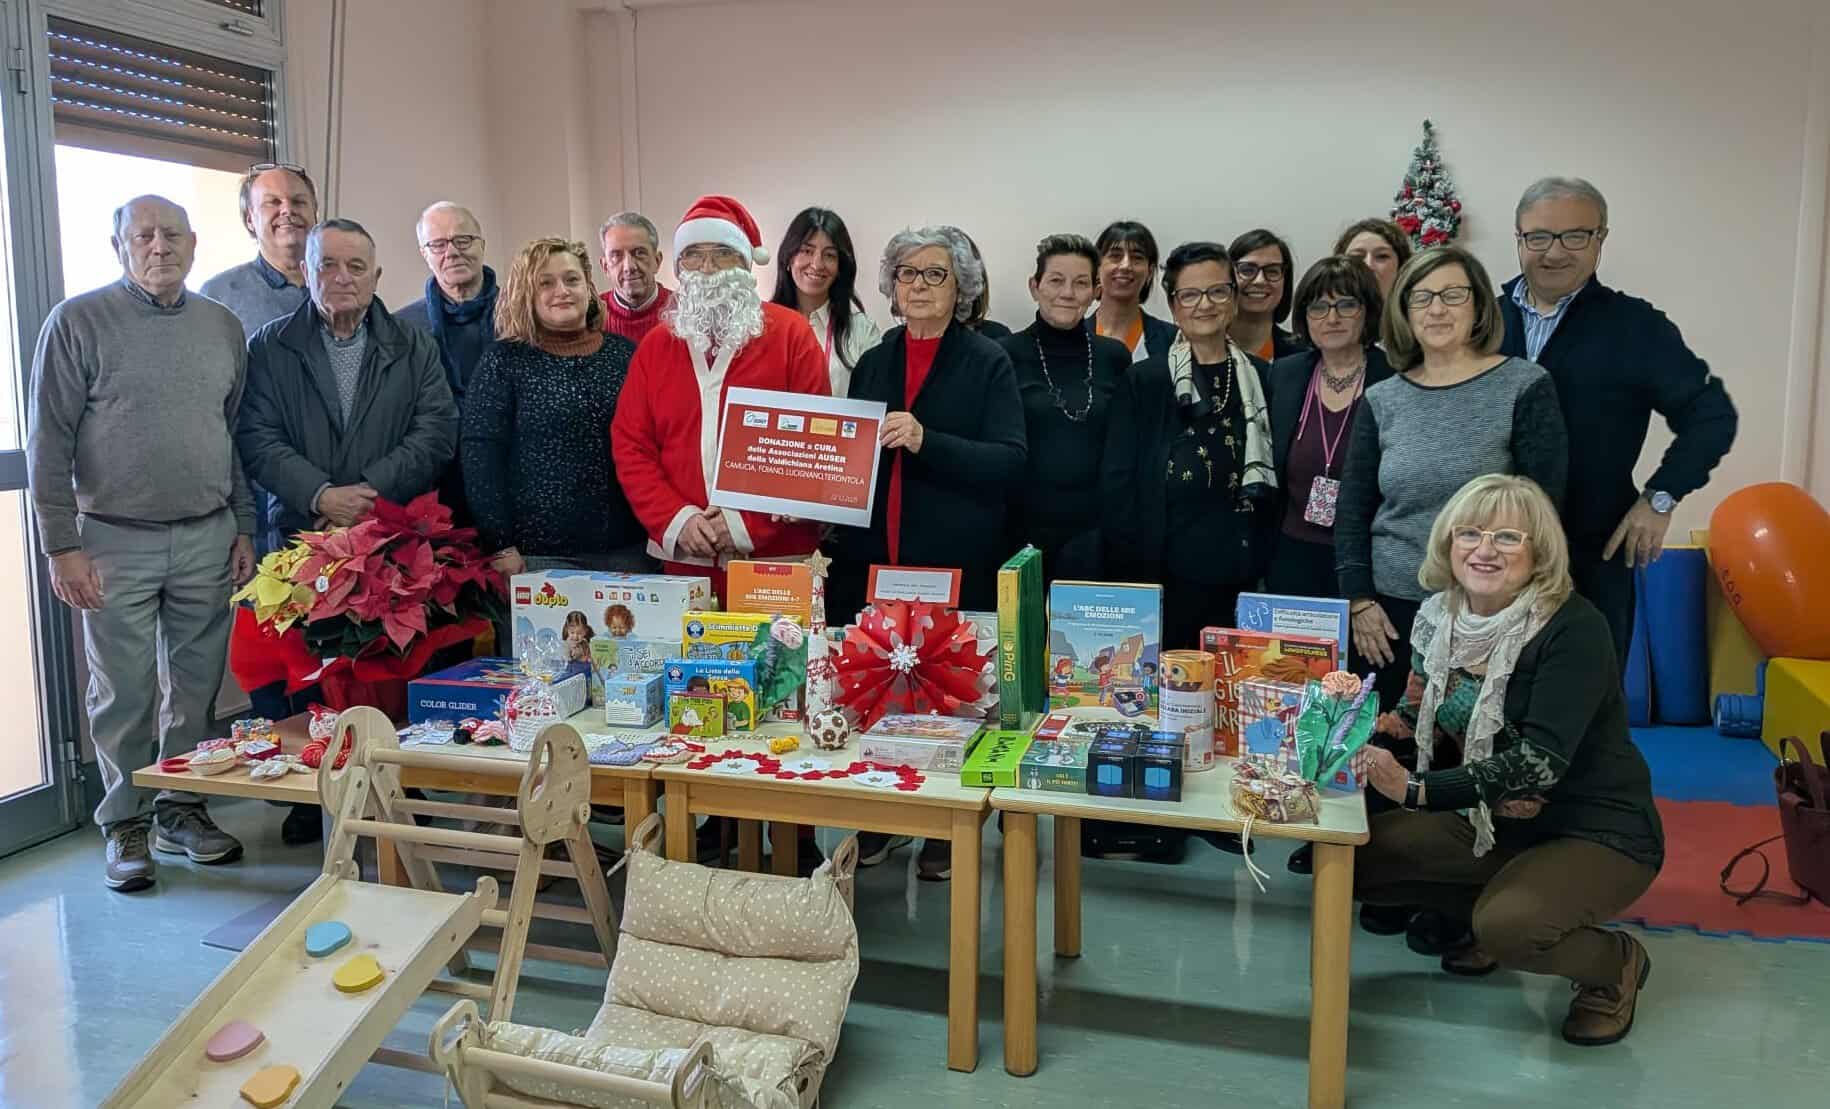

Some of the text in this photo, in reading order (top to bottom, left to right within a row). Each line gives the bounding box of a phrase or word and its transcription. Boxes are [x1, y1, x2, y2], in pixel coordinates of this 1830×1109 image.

[759, 437, 805, 449] DONAZIONE
[814, 442, 836, 452] CURA
[747, 445, 846, 464] delle Associazioni AUSER
[768, 457, 813, 469] Valdichiana
[814, 462, 844, 472] Aretina
[535, 593, 569, 608] duplo
[1073, 604, 1095, 612] L'ABC
[1219, 651, 1242, 676] IL
[420, 699, 477, 711] COLOR GLIDER
